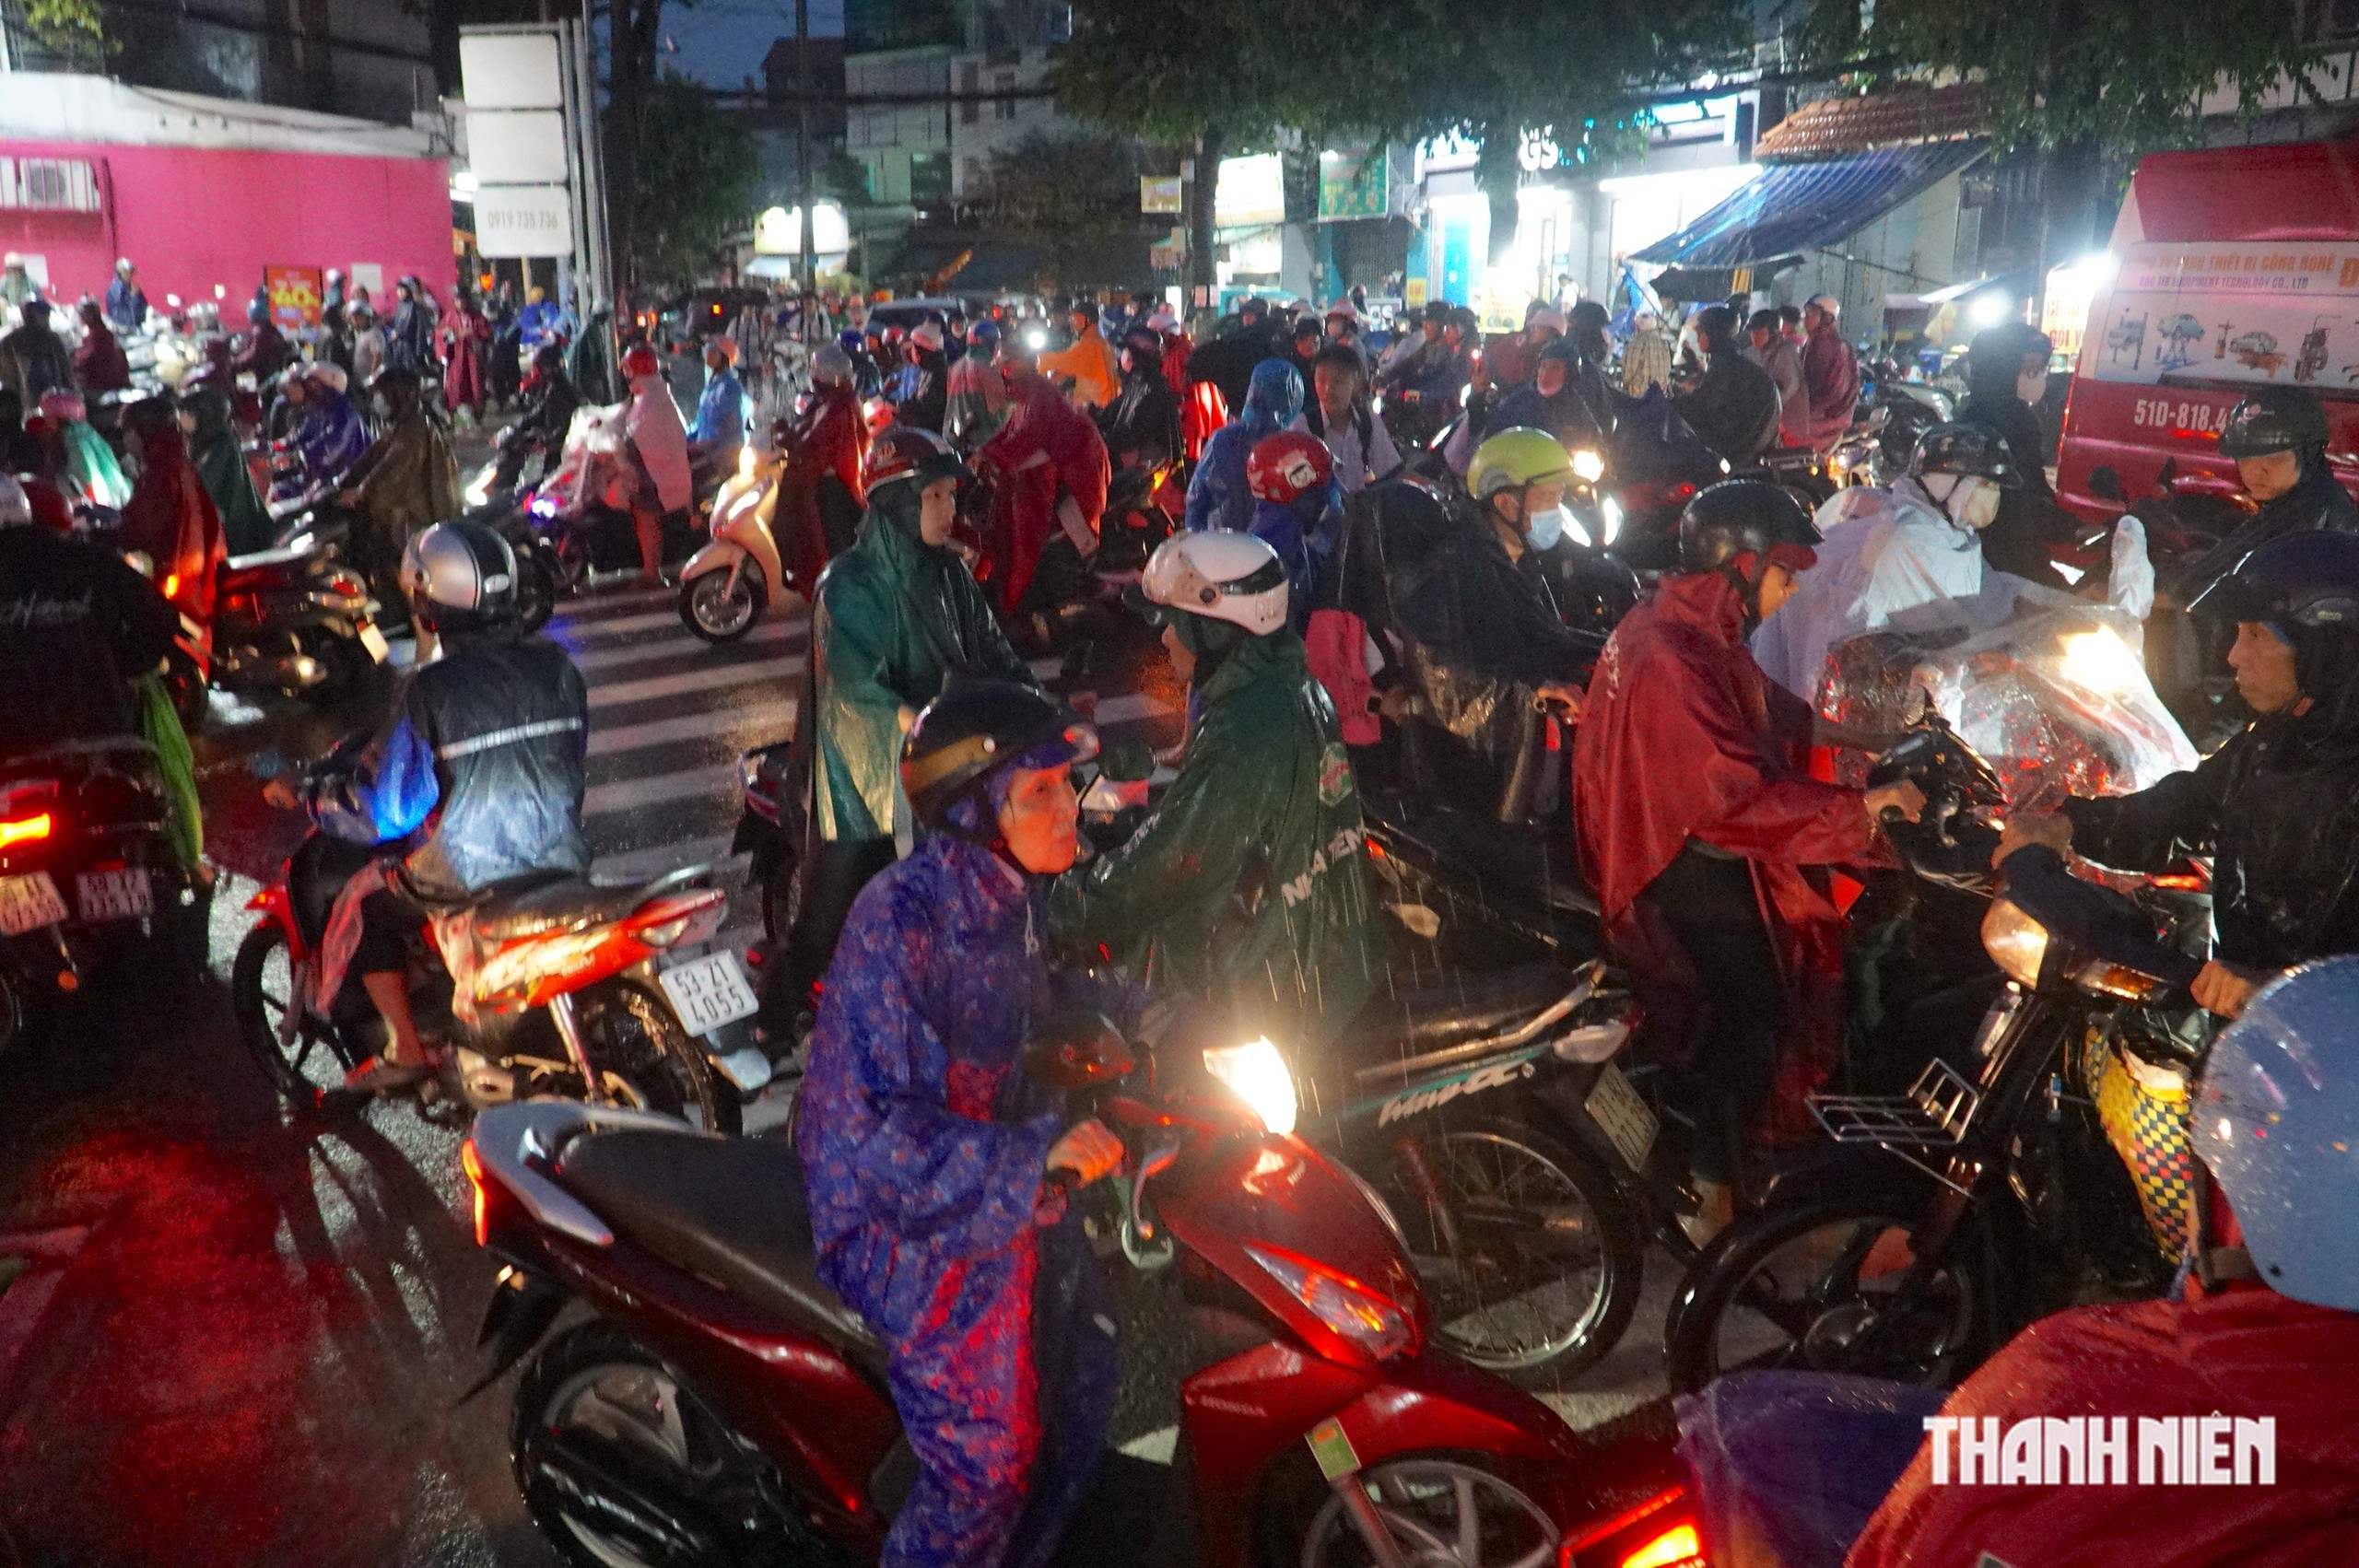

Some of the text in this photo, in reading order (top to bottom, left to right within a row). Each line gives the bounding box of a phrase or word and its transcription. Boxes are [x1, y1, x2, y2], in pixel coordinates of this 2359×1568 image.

[2291, 277, 2309, 289] LTD
[2133, 398, 2230, 435] 51D-818.4
[690, 985, 745, 1024] 4055
